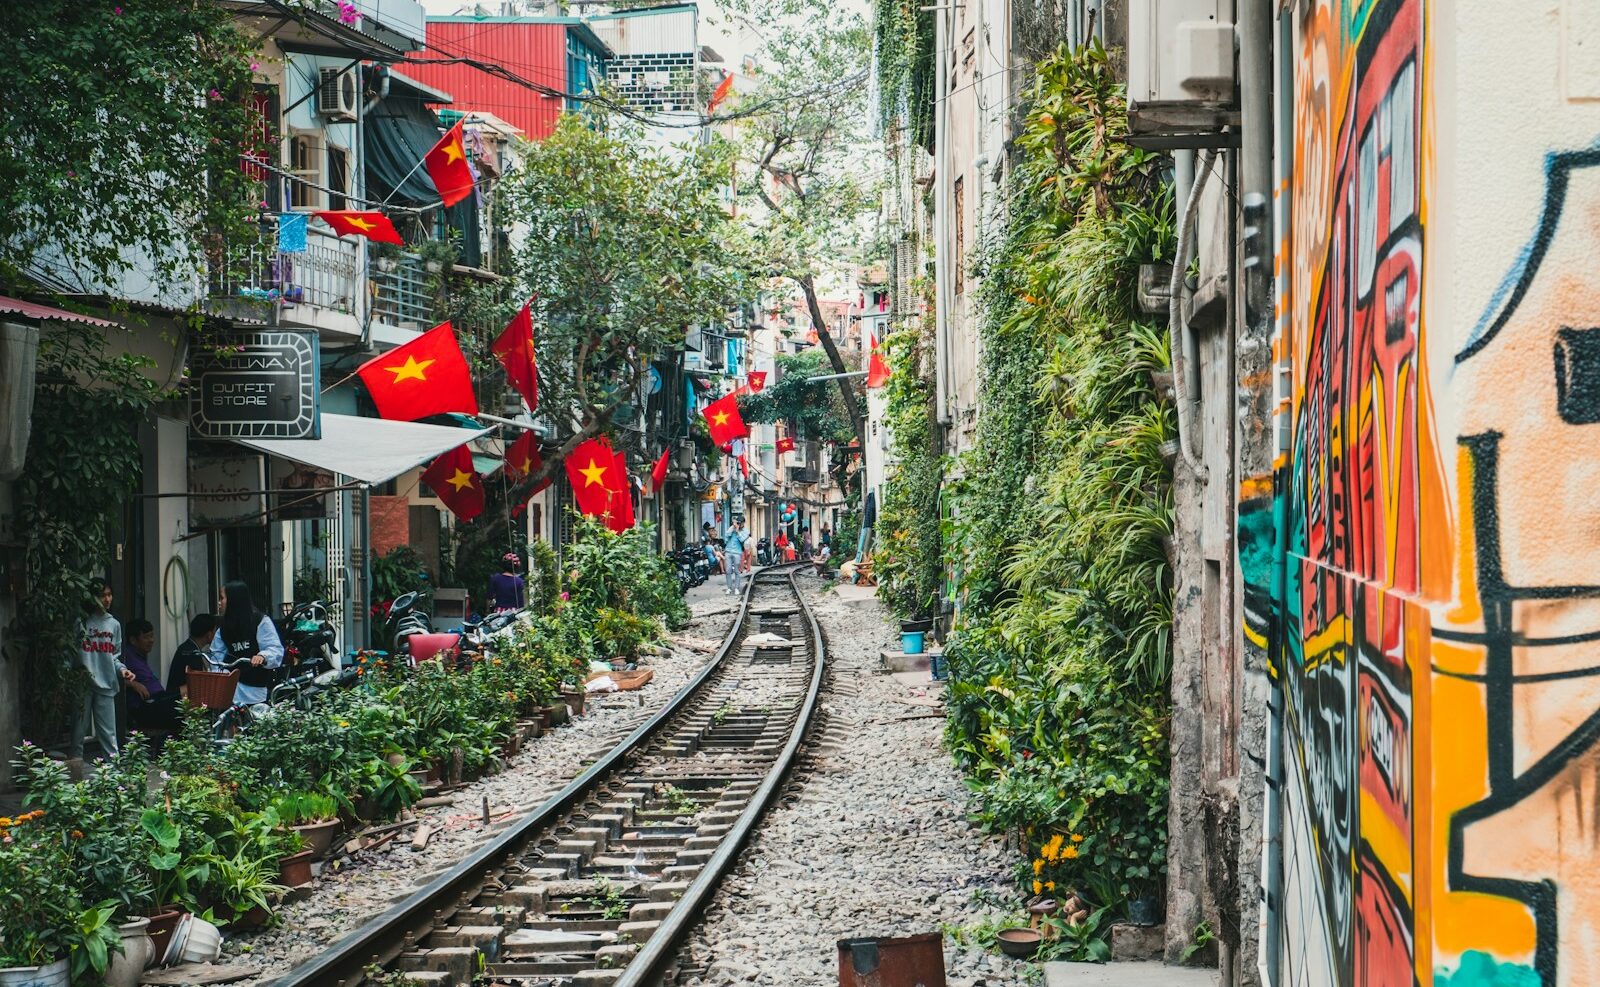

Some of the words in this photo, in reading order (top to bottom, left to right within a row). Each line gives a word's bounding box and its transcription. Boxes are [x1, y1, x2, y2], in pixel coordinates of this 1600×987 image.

[192, 357, 298, 369] RAILWAY
[212, 383, 276, 393] OUTFIT
[212, 395, 268, 406] STORE
